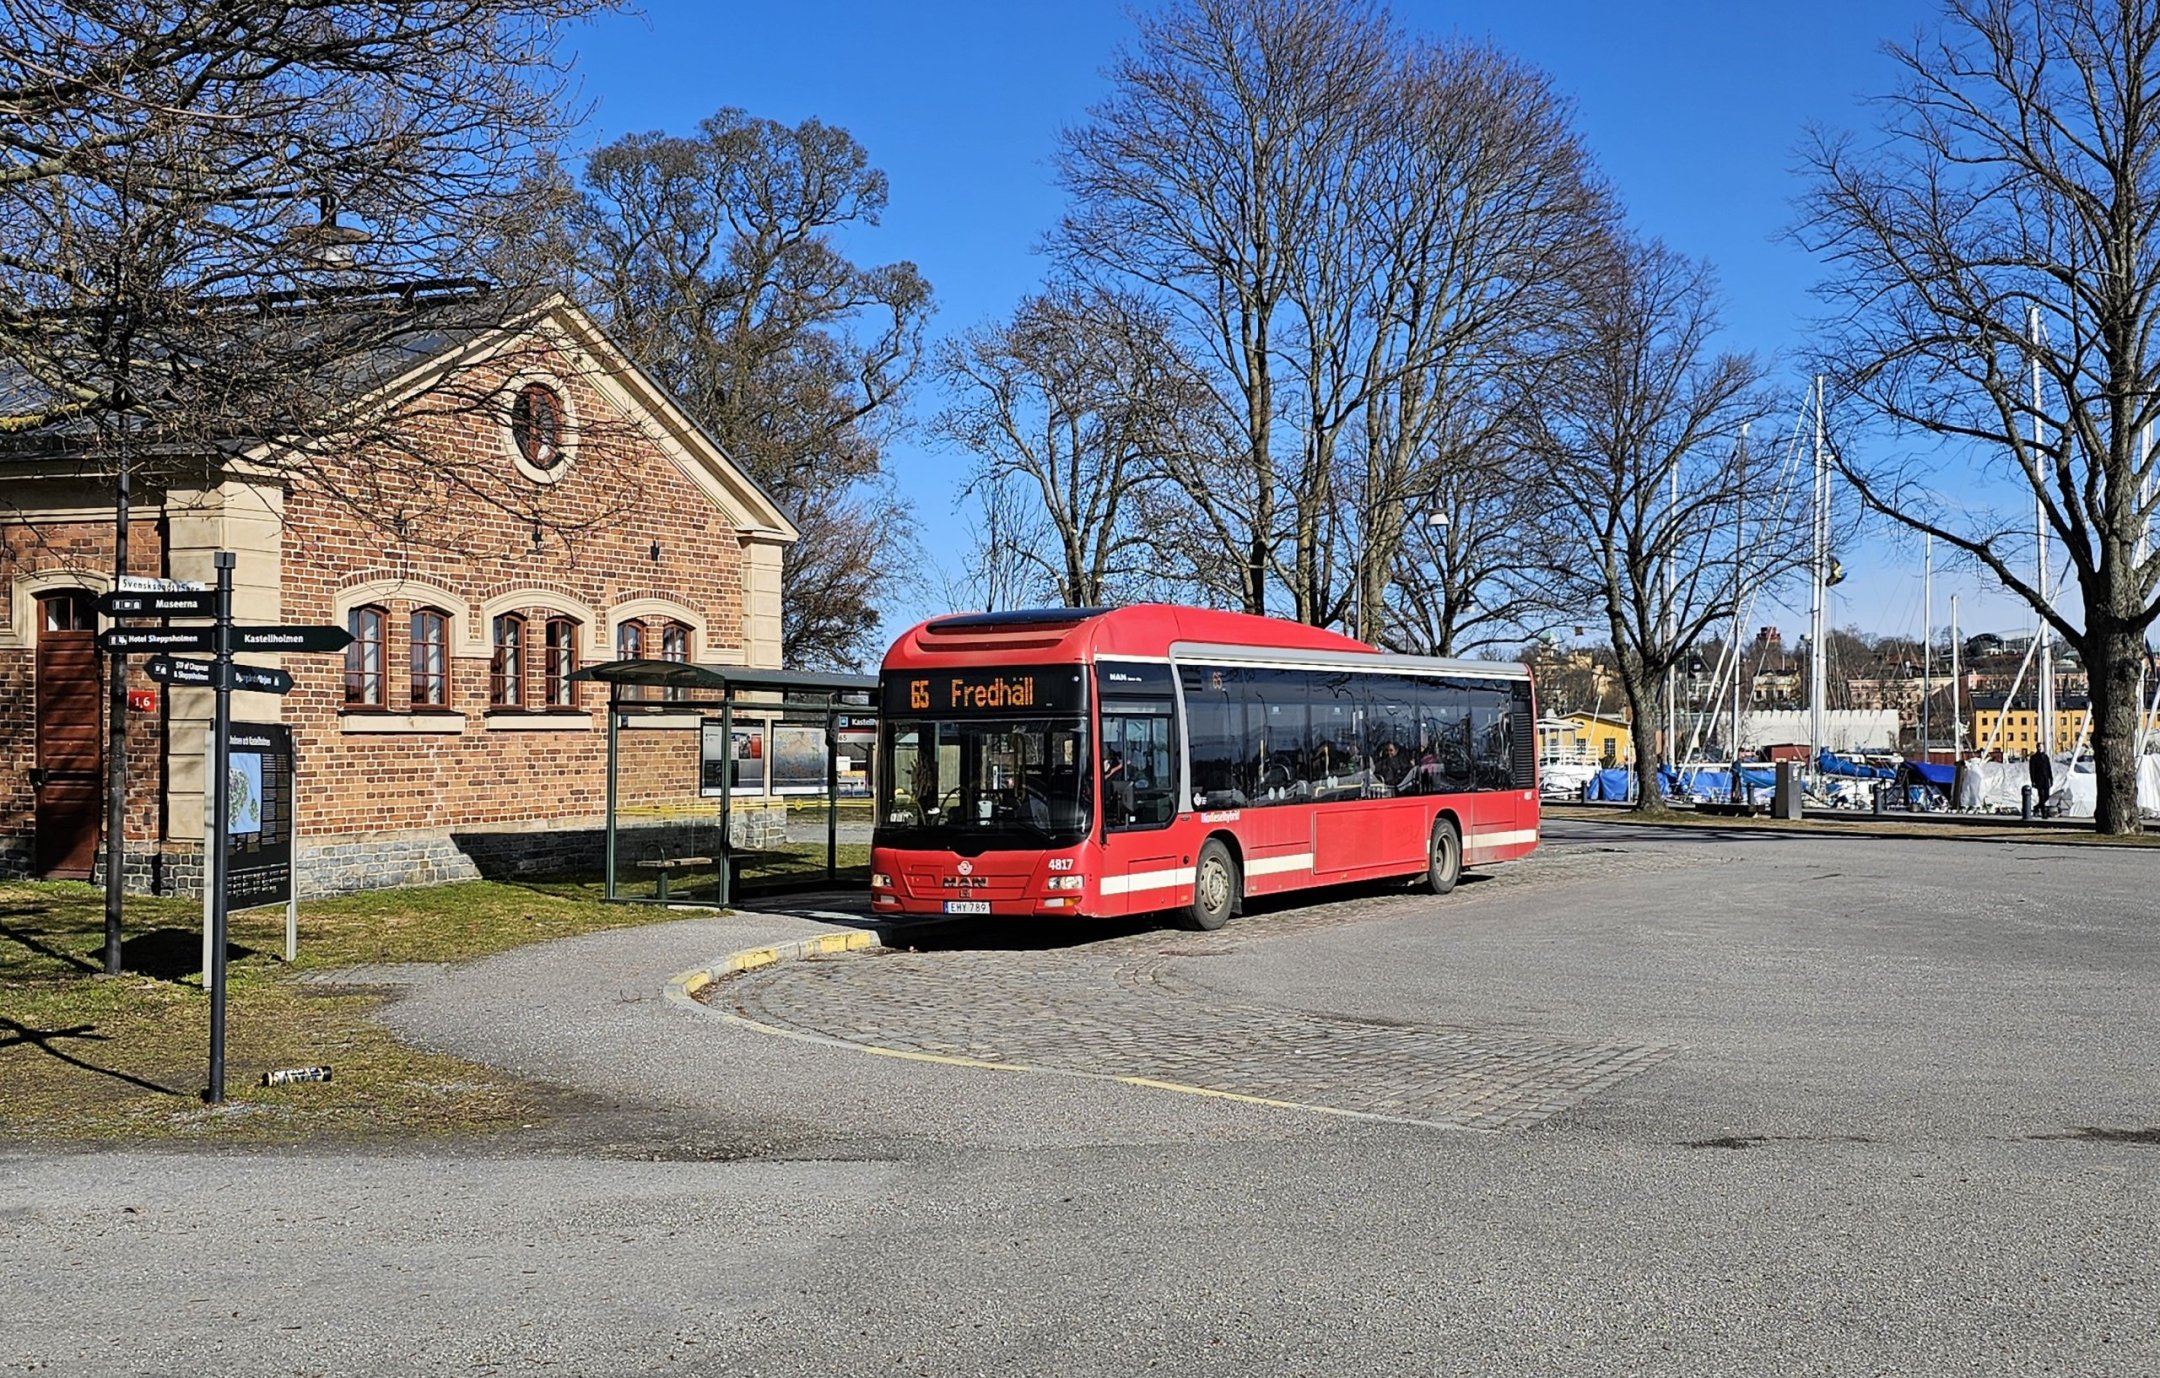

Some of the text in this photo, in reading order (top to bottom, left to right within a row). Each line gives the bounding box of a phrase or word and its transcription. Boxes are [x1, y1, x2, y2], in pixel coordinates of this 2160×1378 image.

[155, 599, 198, 609] Museerna
[128, 634, 198, 644] Hotel Skeppsholmen
[244, 634, 304, 643] Kastellholmen
[1109, 673, 1127, 681] MAN
[1213, 672, 1223, 689] 65
[911, 677, 1033, 708] 65 Fredhäll
[1048, 859, 1074, 871] 4817
[943, 877, 989, 888] MAN
[950, 904, 987, 913] EHY 789
